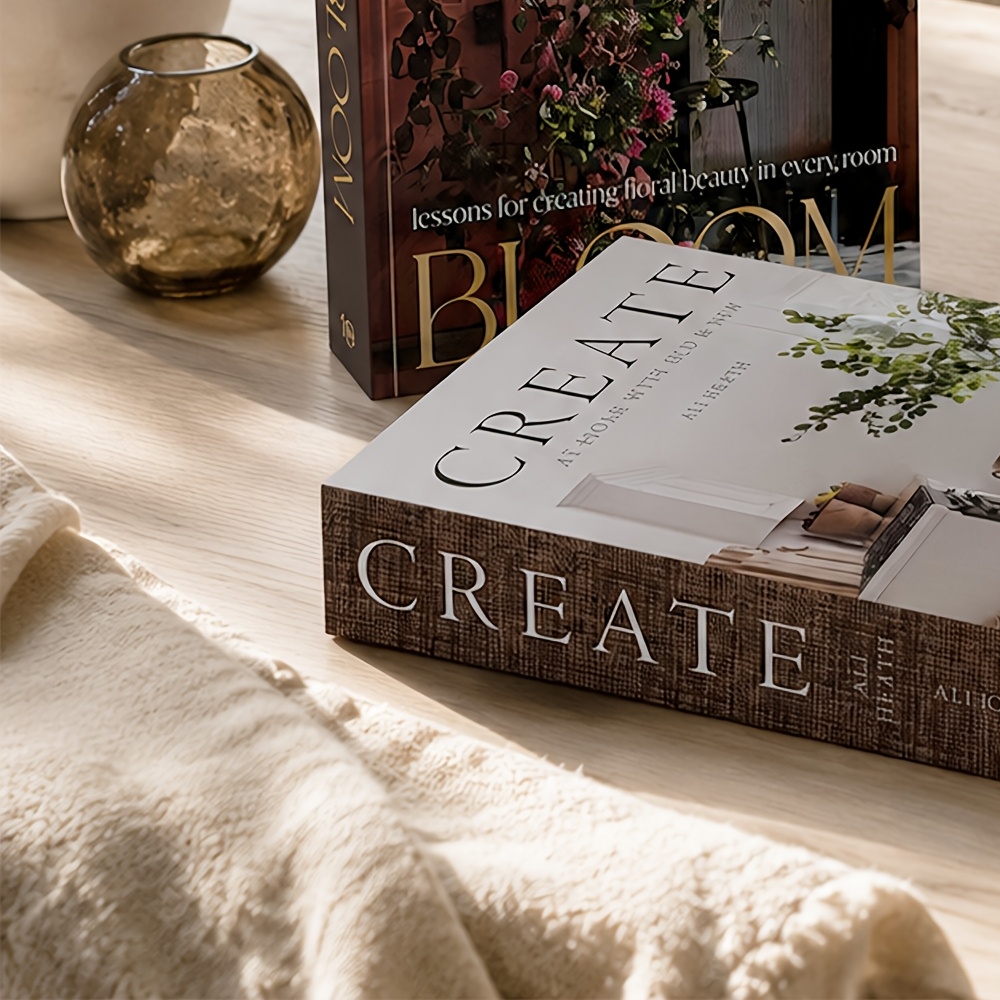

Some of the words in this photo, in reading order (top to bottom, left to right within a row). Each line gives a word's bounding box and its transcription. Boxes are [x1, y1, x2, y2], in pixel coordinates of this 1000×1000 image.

[412, 202, 493, 231] lessons
[498, 194, 529, 219] for
[532, 184, 622, 215] creating
[681, 166, 753, 192] beauty
[757, 159, 777, 181] in
[842, 145, 898, 170] room
[413, 185, 898, 371] BLM
[433, 261, 737, 489] CREATE
[356, 538, 811, 697] CREATE
